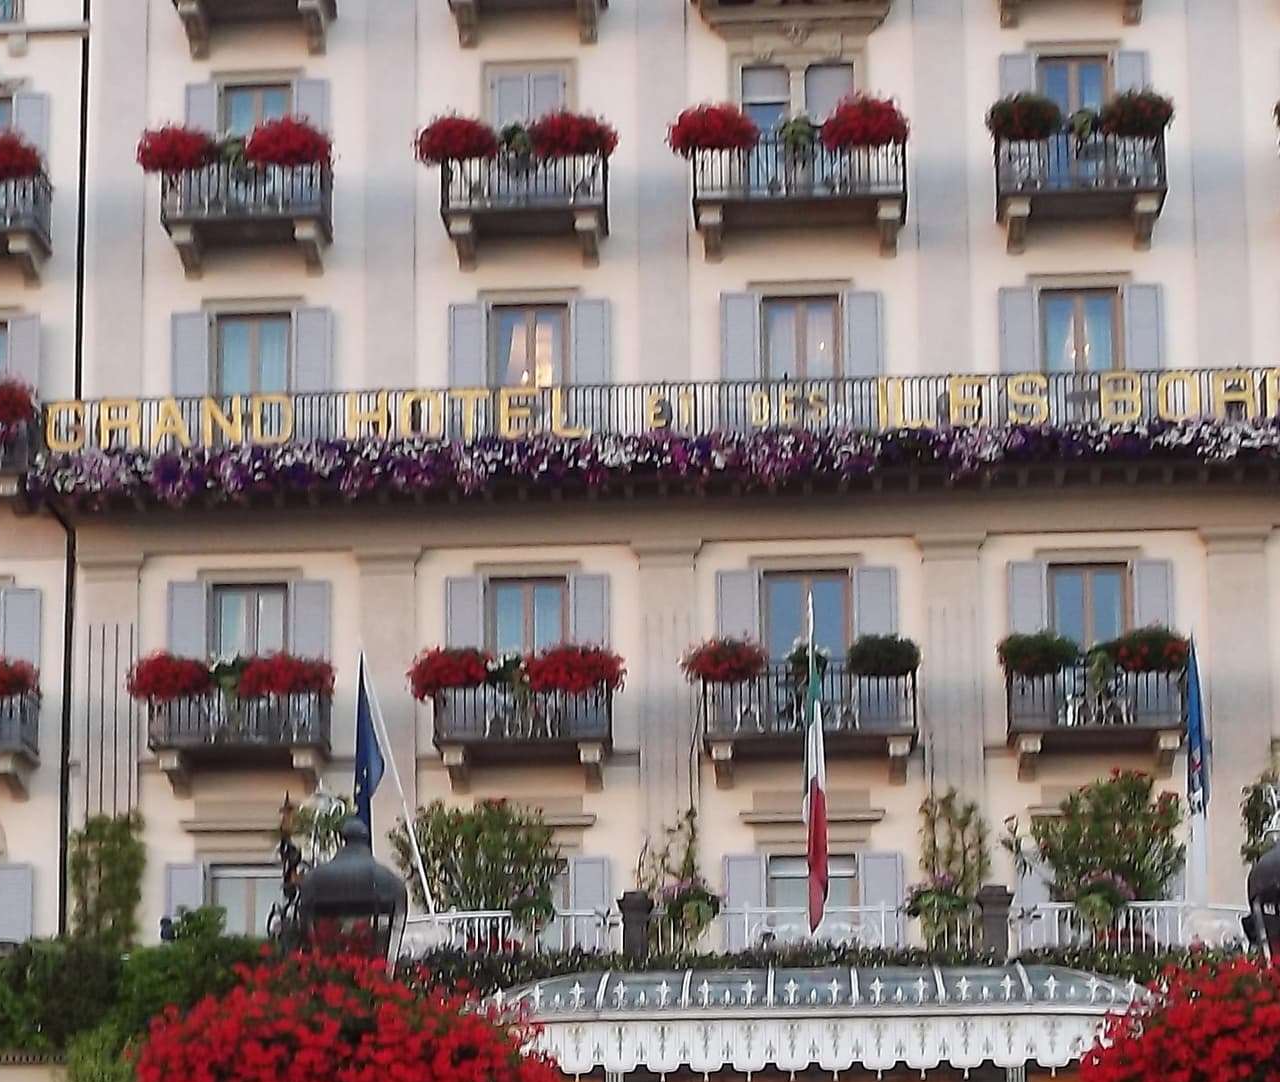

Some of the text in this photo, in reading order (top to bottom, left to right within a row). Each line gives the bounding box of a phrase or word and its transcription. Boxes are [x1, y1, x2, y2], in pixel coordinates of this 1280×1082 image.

[45, 391, 294, 451] GRAND
[345, 386, 592, 440] HOTEL
[751, 388, 828, 428] DES
[877, 372, 1049, 428] ILES
